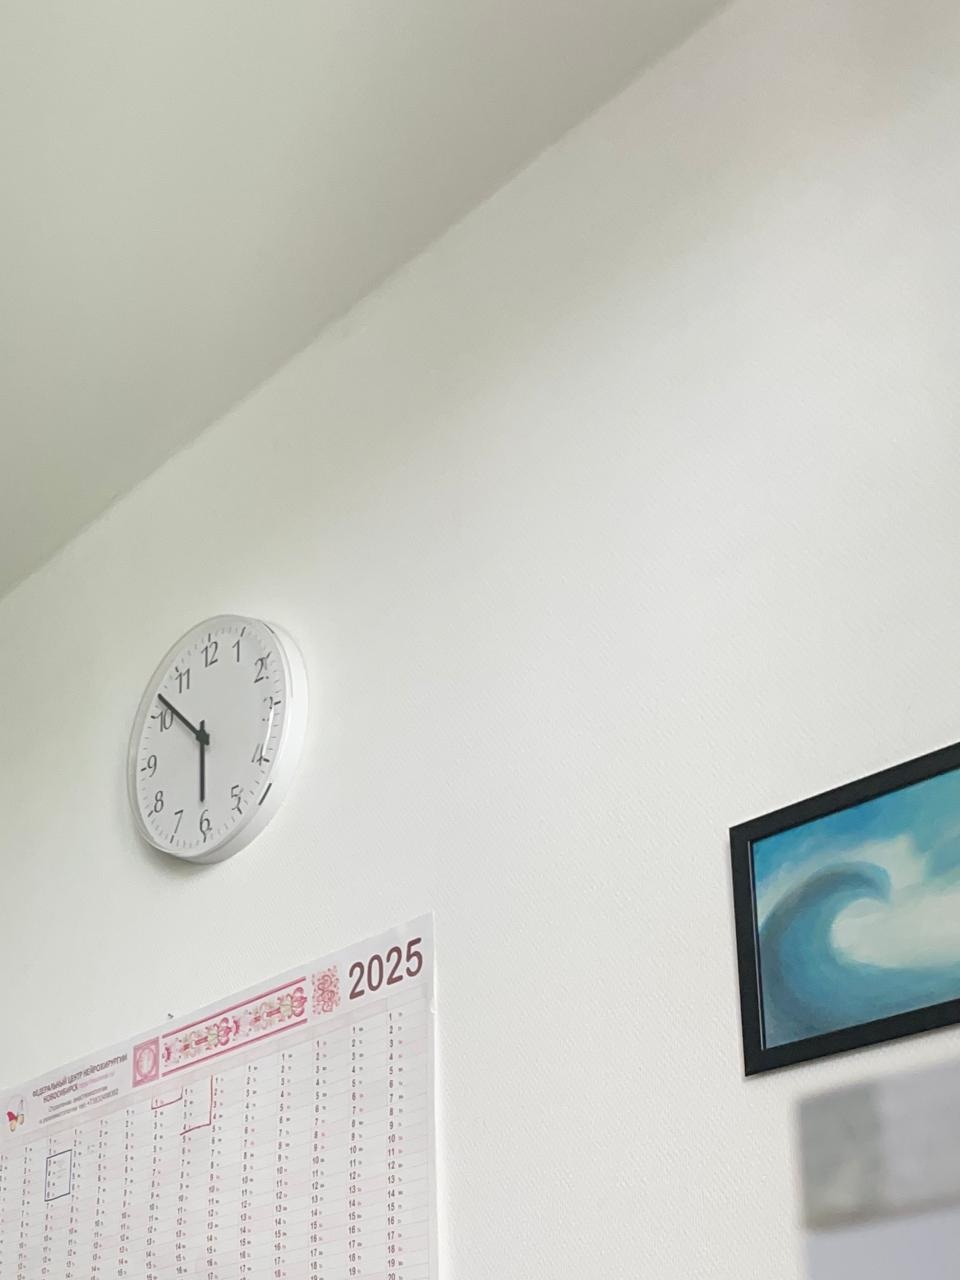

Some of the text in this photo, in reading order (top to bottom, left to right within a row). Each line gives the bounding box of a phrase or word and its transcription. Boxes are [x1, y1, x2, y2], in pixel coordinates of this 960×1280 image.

[201, 641, 218, 667] 12
[232, 639, 240, 662] 1
[175, 667, 190, 693] 11
[254, 657, 267, 683] 2
[157, 710, 174, 732] 10
[147, 754, 158, 778] 9
[153, 790, 164, 813] 8
[230, 784, 241, 811] 5
[174, 809, 184, 834] 7
[199, 809, 211, 834] 6
[348, 937, 423, 1000] 2025
